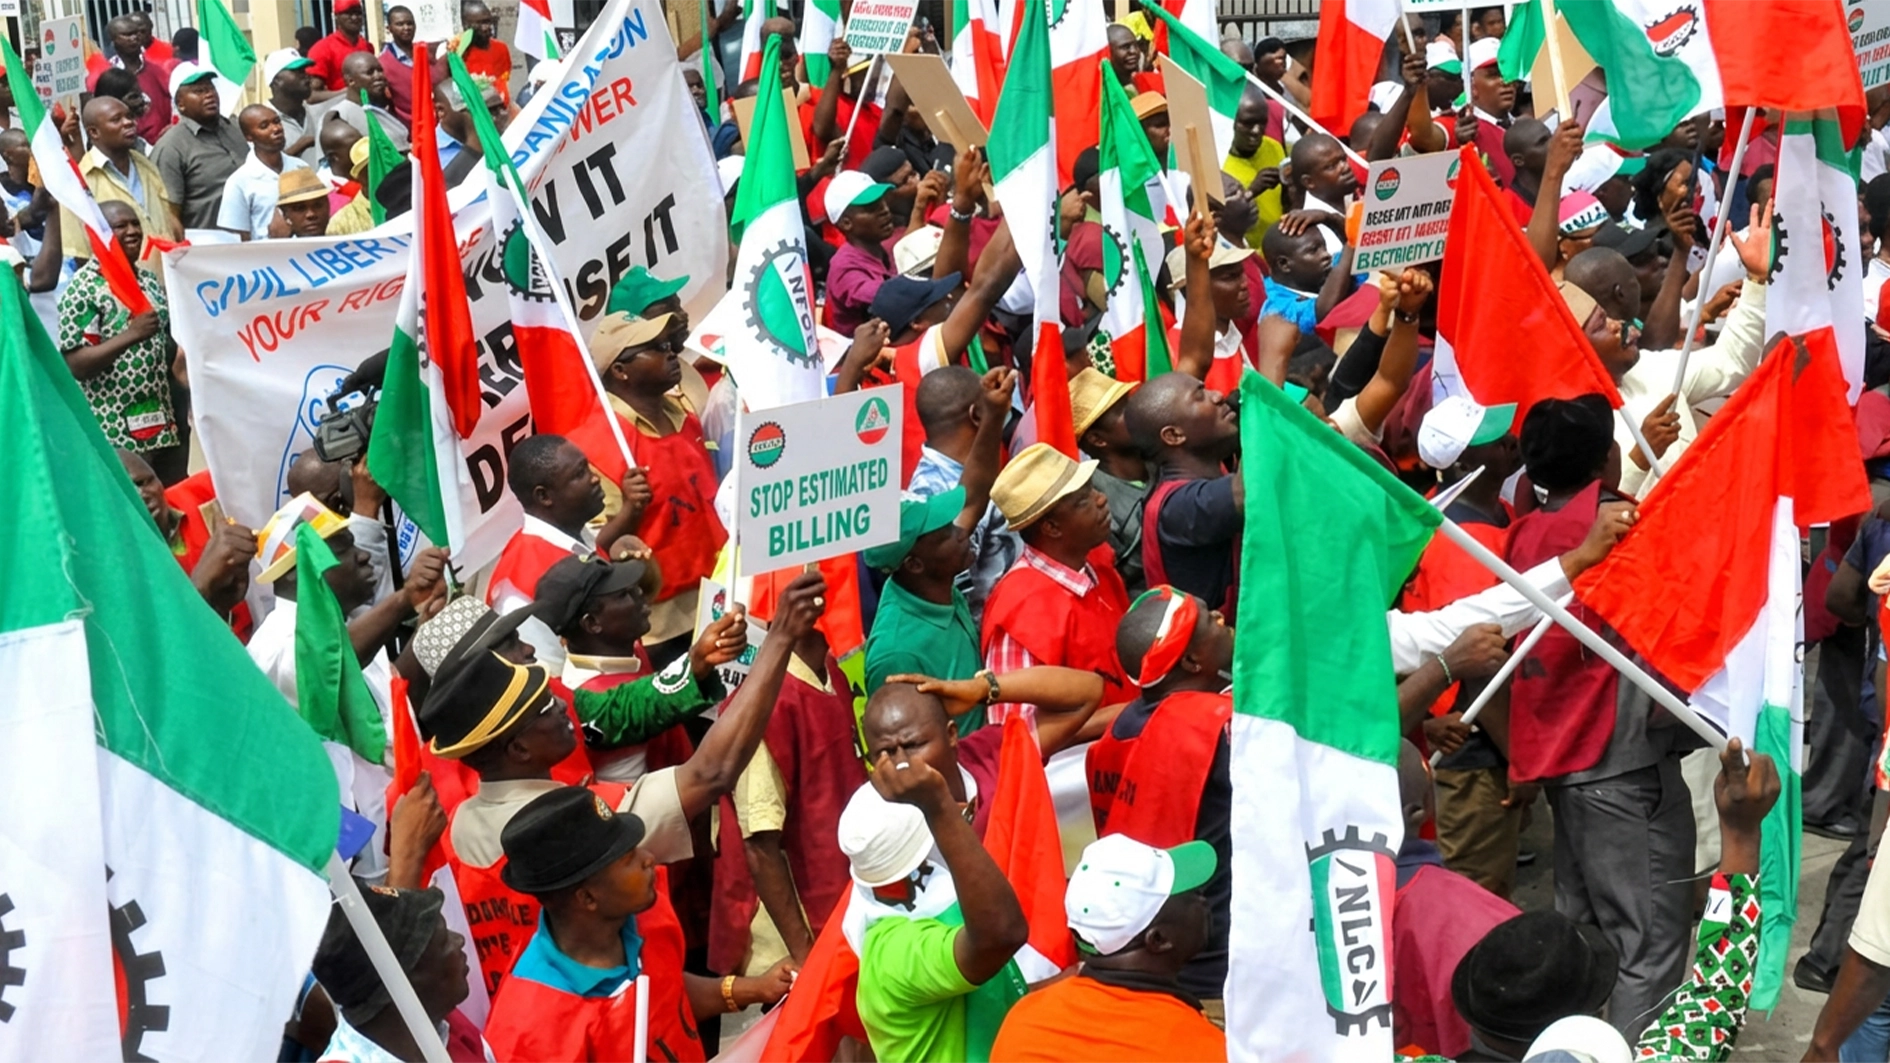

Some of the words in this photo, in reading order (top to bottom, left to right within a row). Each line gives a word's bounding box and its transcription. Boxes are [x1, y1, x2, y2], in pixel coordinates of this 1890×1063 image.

[236, 297, 329, 364] YOUR
[336, 274, 406, 315] RIG
[564, 75, 638, 147] WER
[572, 141, 627, 221] IT
[644, 192, 680, 269] IT
[197, 265, 301, 318] CIVIL
[750, 479, 794, 518] STOP
[799, 457, 889, 507] ESTIMATED
[769, 503, 871, 557] BILLING
[1335, 884, 1376, 975] NLC
